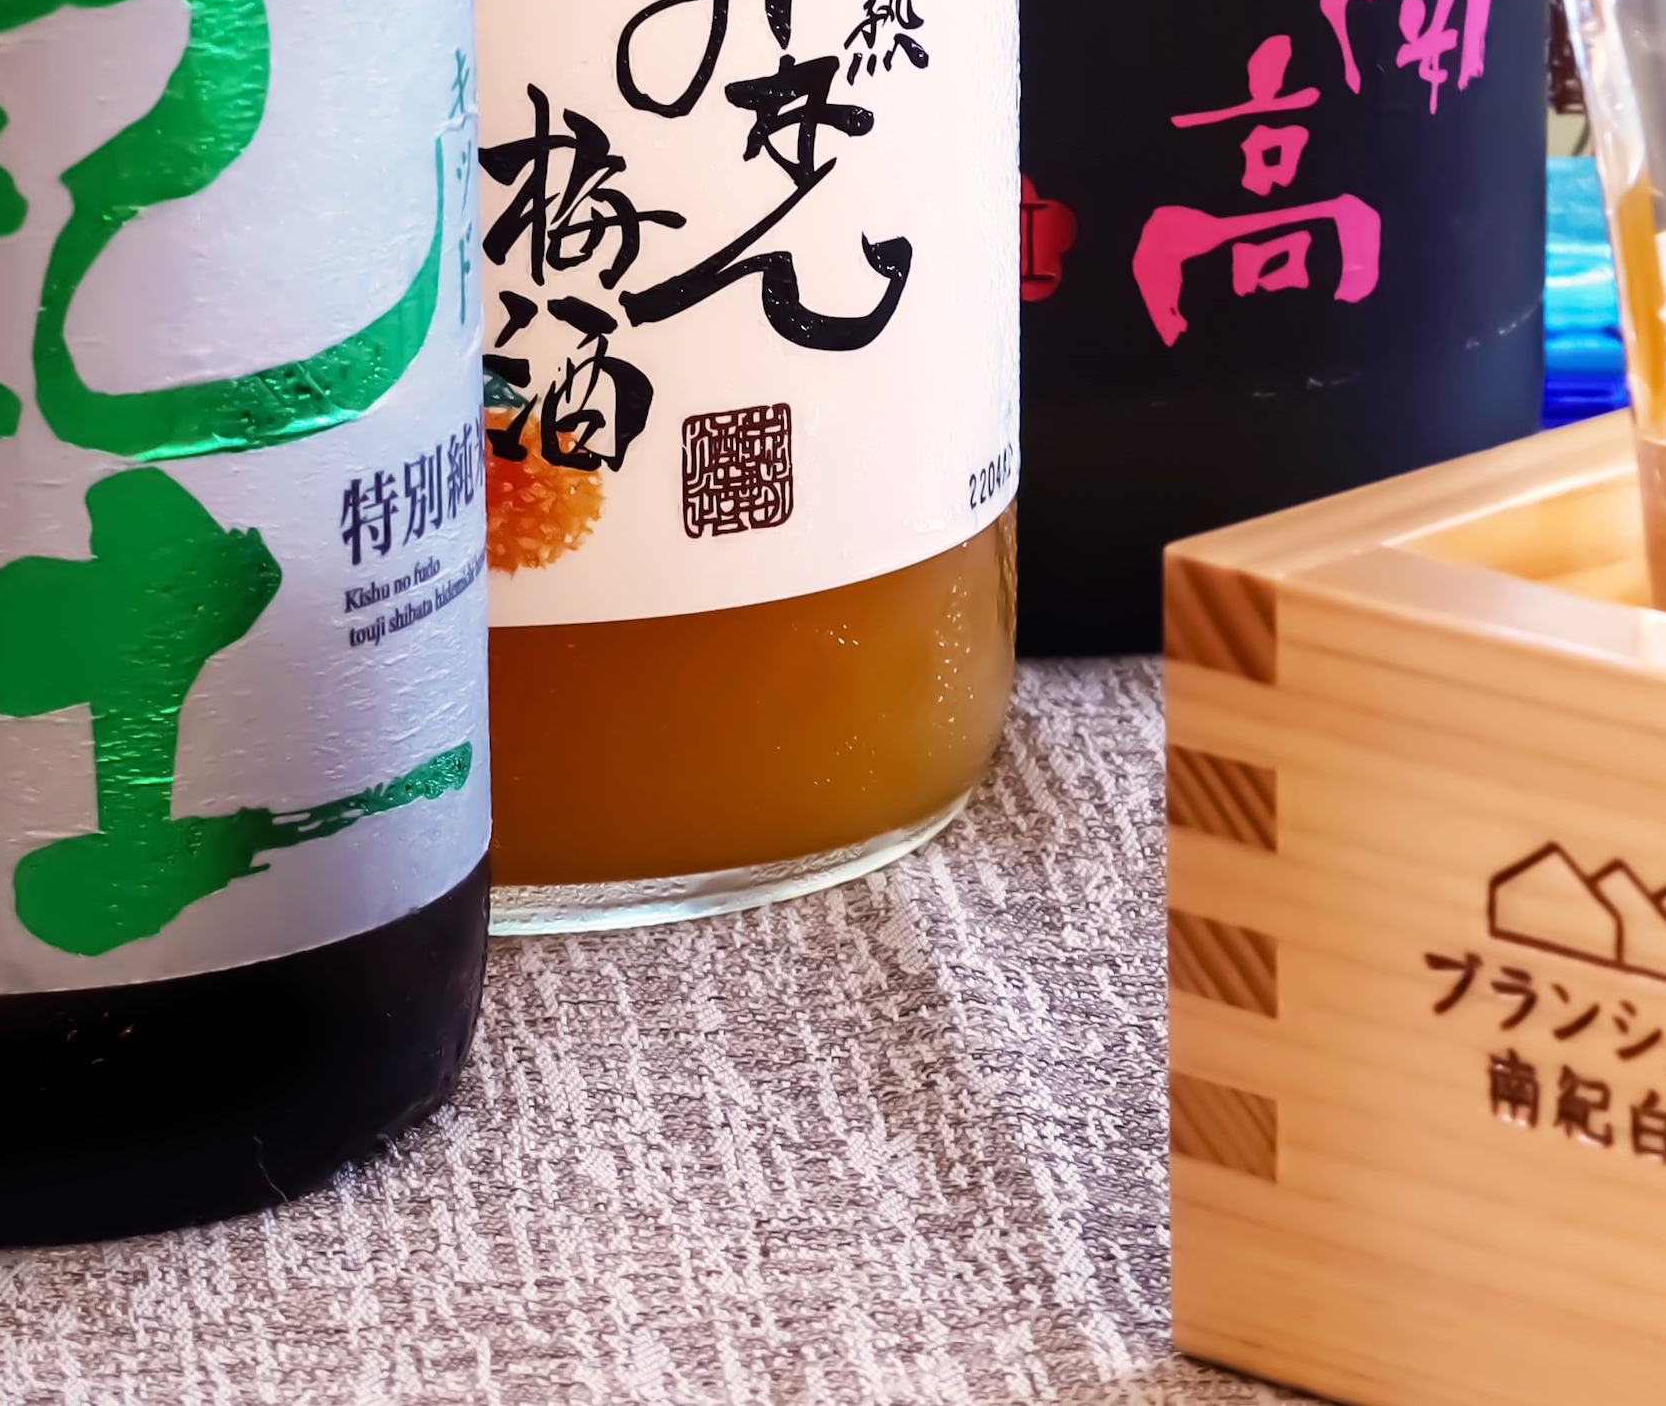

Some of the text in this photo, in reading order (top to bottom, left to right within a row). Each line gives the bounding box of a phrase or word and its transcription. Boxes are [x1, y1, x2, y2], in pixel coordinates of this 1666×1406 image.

[479, 83, 686, 471] 梅酒
[344, 579, 391, 613] Kishu
[394, 575, 411, 594] no
[414, 555, 440, 586] fudo
[349, 614, 386, 647] touji
[388, 597, 434, 634] shibata
